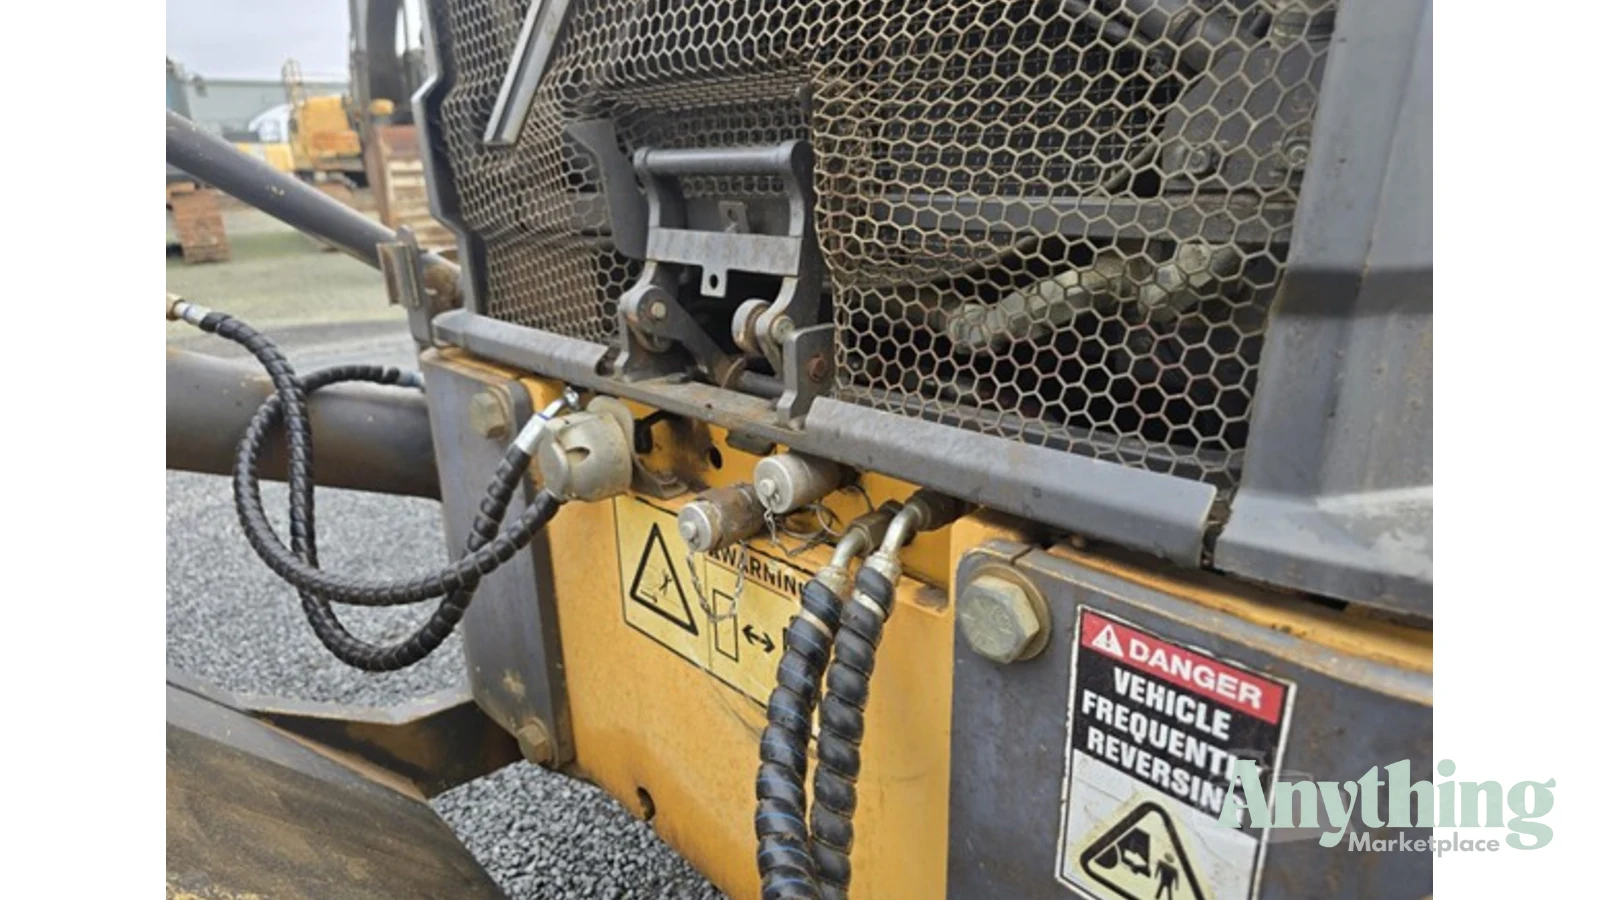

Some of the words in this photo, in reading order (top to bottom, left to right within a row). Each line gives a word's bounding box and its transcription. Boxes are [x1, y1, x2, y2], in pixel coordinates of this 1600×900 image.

[718, 546, 805, 600] WARNIN
[1113, 666, 1232, 741] VEHICLE
[1129, 638, 1263, 709] DANGER
